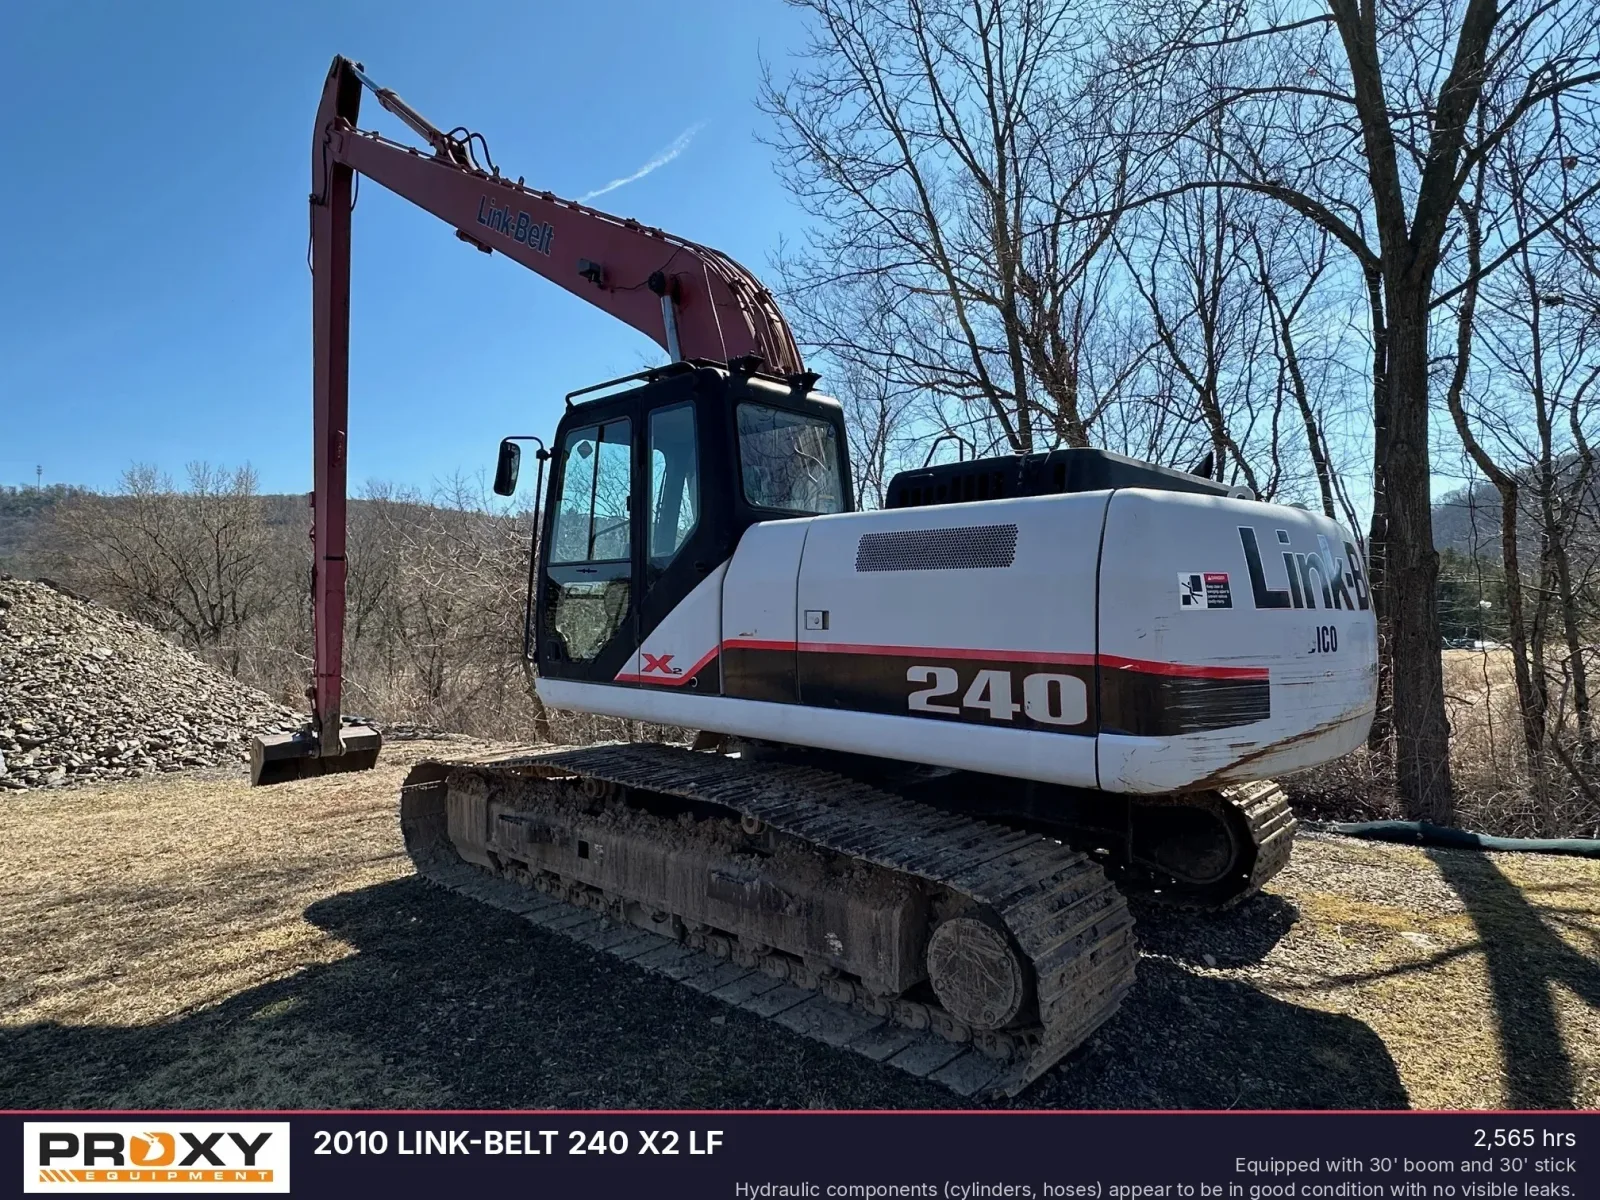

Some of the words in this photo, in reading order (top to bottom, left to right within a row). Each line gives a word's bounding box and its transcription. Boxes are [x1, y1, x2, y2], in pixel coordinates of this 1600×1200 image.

[477, 195, 554, 257] Link-Belt
[1308, 626, 1338, 653] ICO
[906, 665, 1088, 726] 240
